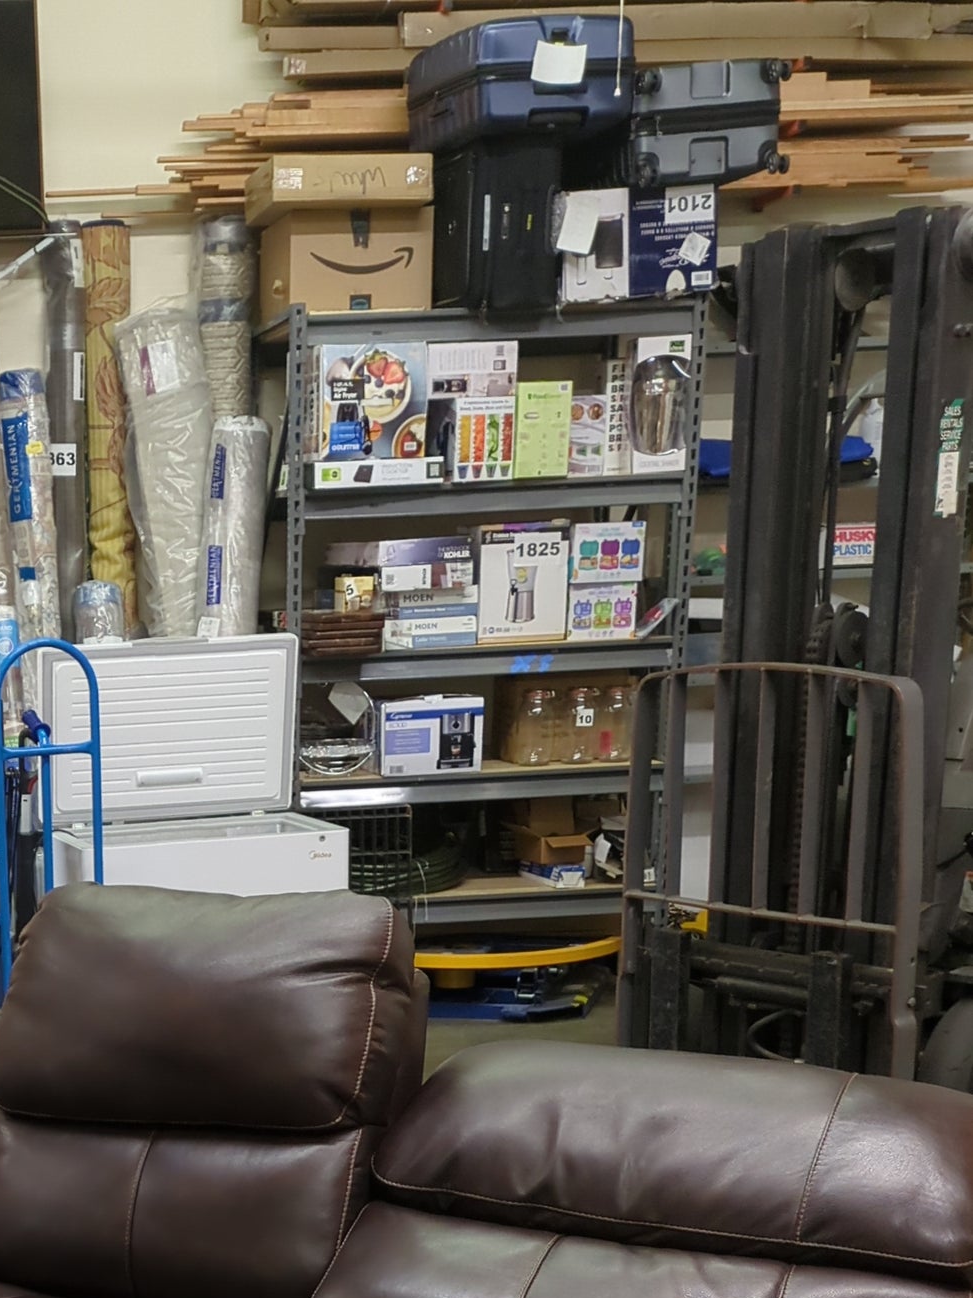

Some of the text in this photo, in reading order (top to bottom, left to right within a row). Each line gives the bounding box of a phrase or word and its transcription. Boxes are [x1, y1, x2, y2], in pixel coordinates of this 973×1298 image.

[668, 194, 713, 213] 2101
[944, 406, 962, 416] SALES
[940, 418, 963, 428] RENTALS
[940, 430, 962, 440] SERVICE
[942, 441, 959, 450] PARTS
[7, 423, 23, 515] GERTMENIAN
[443, 551, 471, 559] KOHLER
[515, 542, 561, 558] 1825
[833, 544, 872, 556] PLASTIC
[346, 584, 354, 596] 5
[403, 593, 434, 603] MOEN
[414, 622, 438, 630] MOEN
[578, 714, 593, 725] 10
